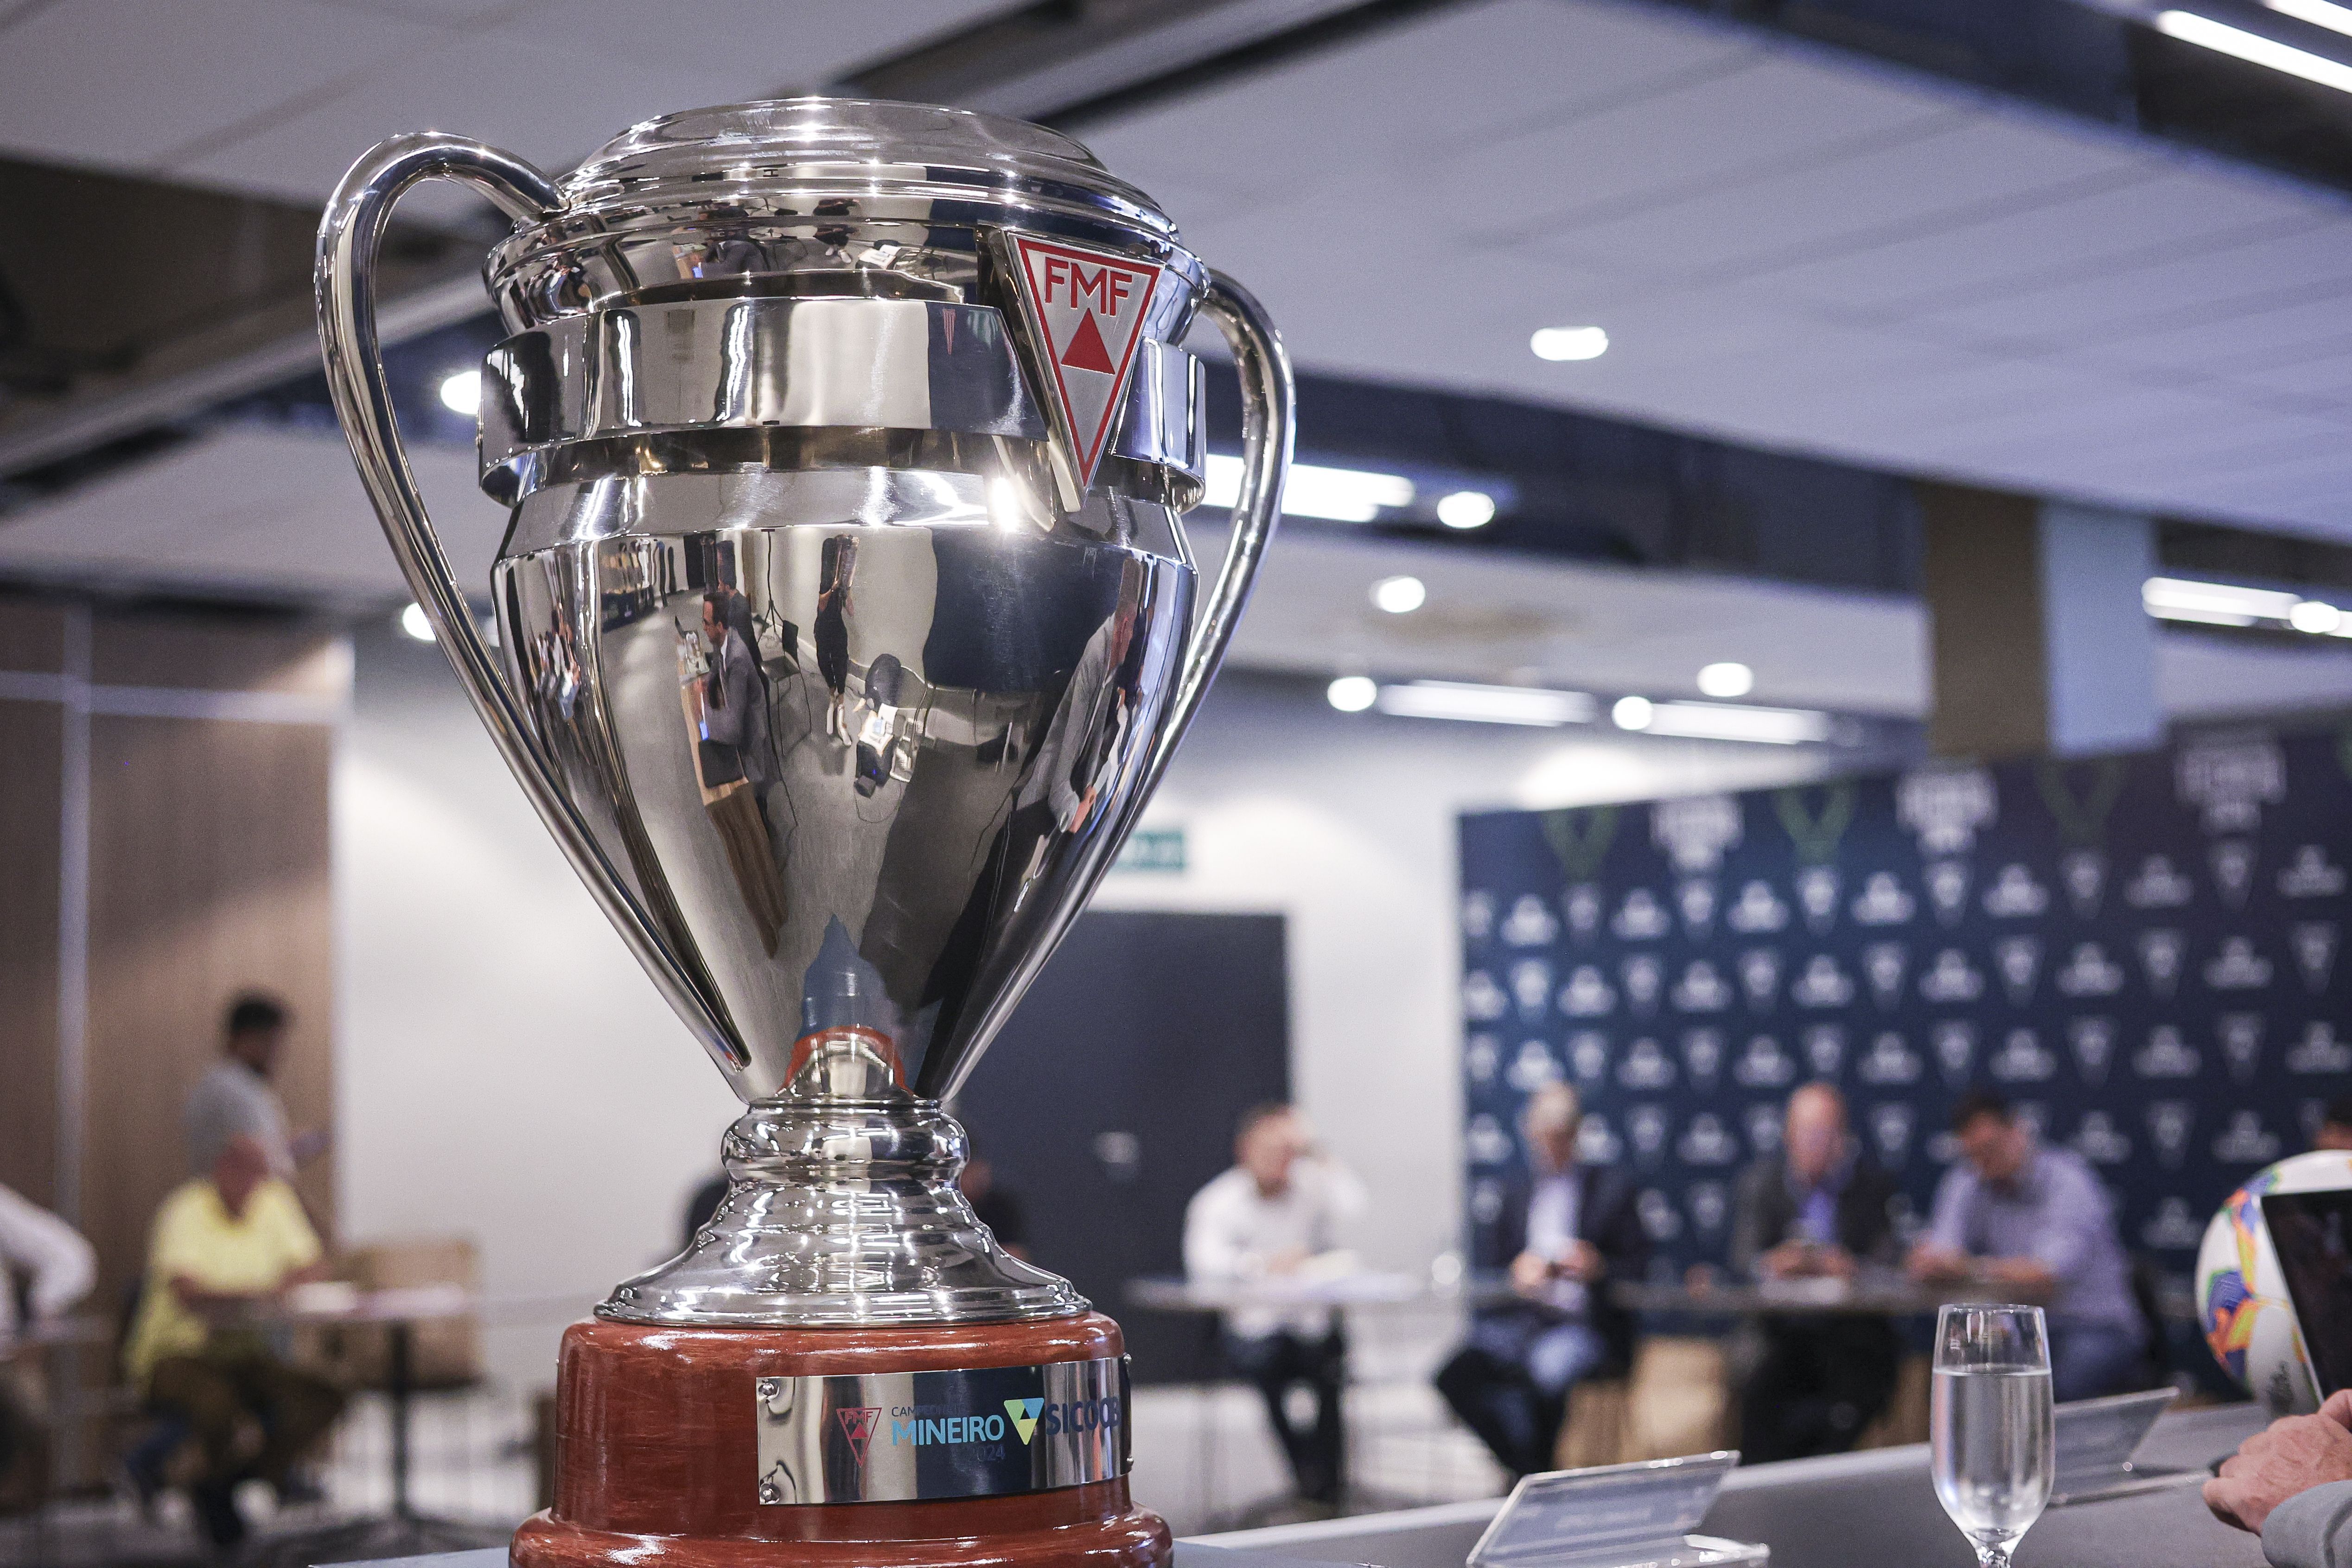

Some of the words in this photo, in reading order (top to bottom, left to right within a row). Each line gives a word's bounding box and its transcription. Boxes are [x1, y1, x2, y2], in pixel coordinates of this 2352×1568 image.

[1044, 256, 1133, 318] FMF
[845, 1411, 873, 1425] FMF
[892, 1415, 1005, 1446] MINEIRO
[1045, 1396, 1122, 1435] SICOOB
